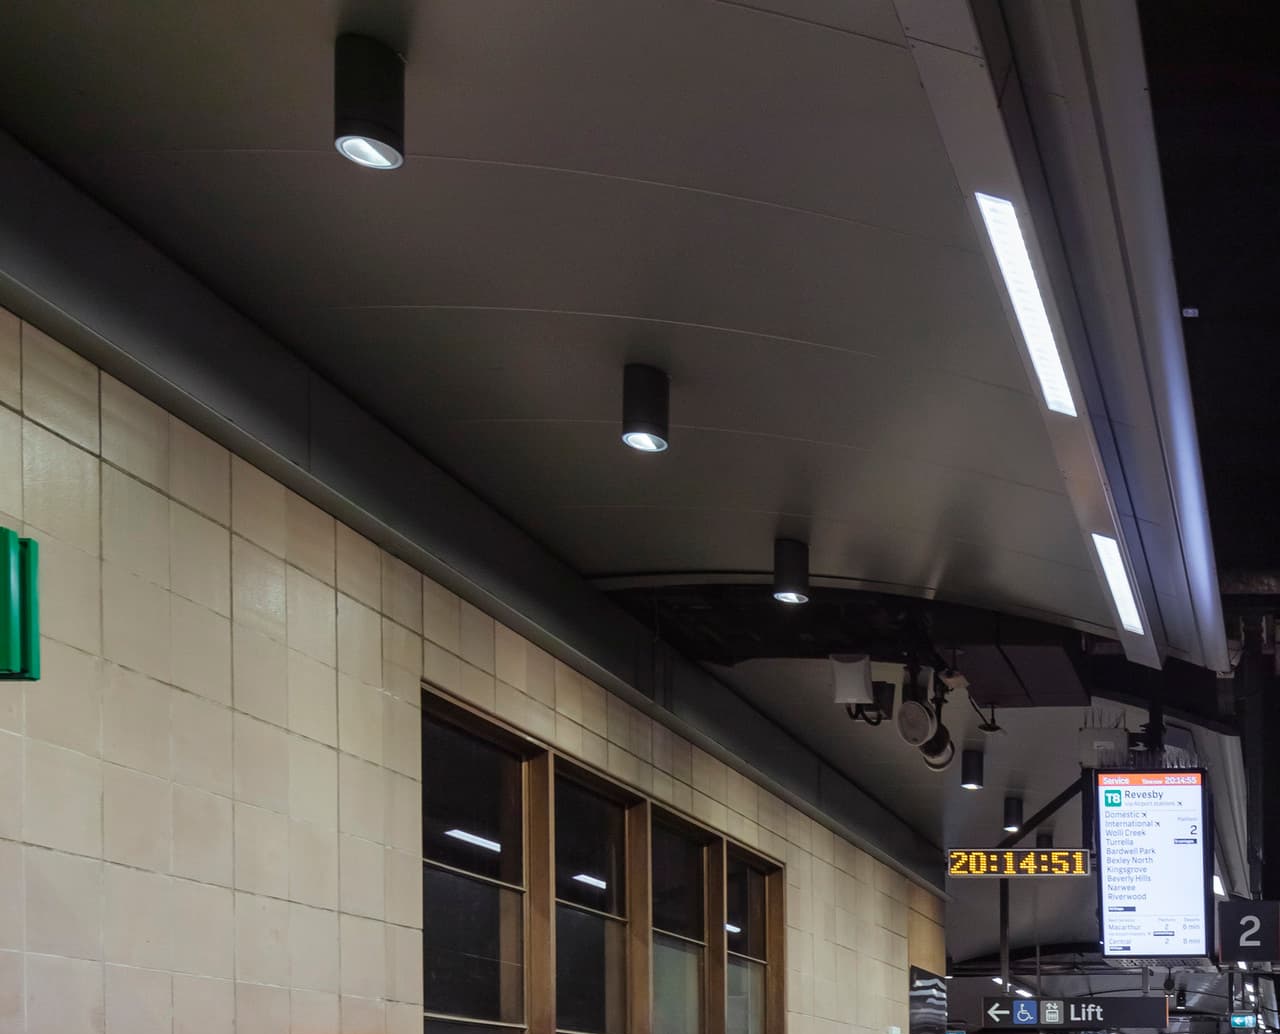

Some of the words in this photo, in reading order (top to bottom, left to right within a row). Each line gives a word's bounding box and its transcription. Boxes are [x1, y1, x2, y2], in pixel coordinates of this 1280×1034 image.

[1105, 792, 1121, 804] T8
[1124, 790, 1164, 800] Revesby
[1105, 820, 1153, 828] International
[1105, 829, 1123, 837] Wolli
[1125, 829, 1146, 837] Creek
[1190, 824, 1198, 835] 2
[1106, 838, 1134, 846] Turrella
[949, 850, 1086, 876] 20:14:51
[1107, 857, 1130, 865] Bexley
[1107, 866, 1147, 875] Kingsgrove
[1107, 875, 1133, 884] Beverly
[1108, 893, 1147, 901] Riverwood
[1238, 915, 1261, 947] 2
[1070, 1003, 1104, 1022] Lift
